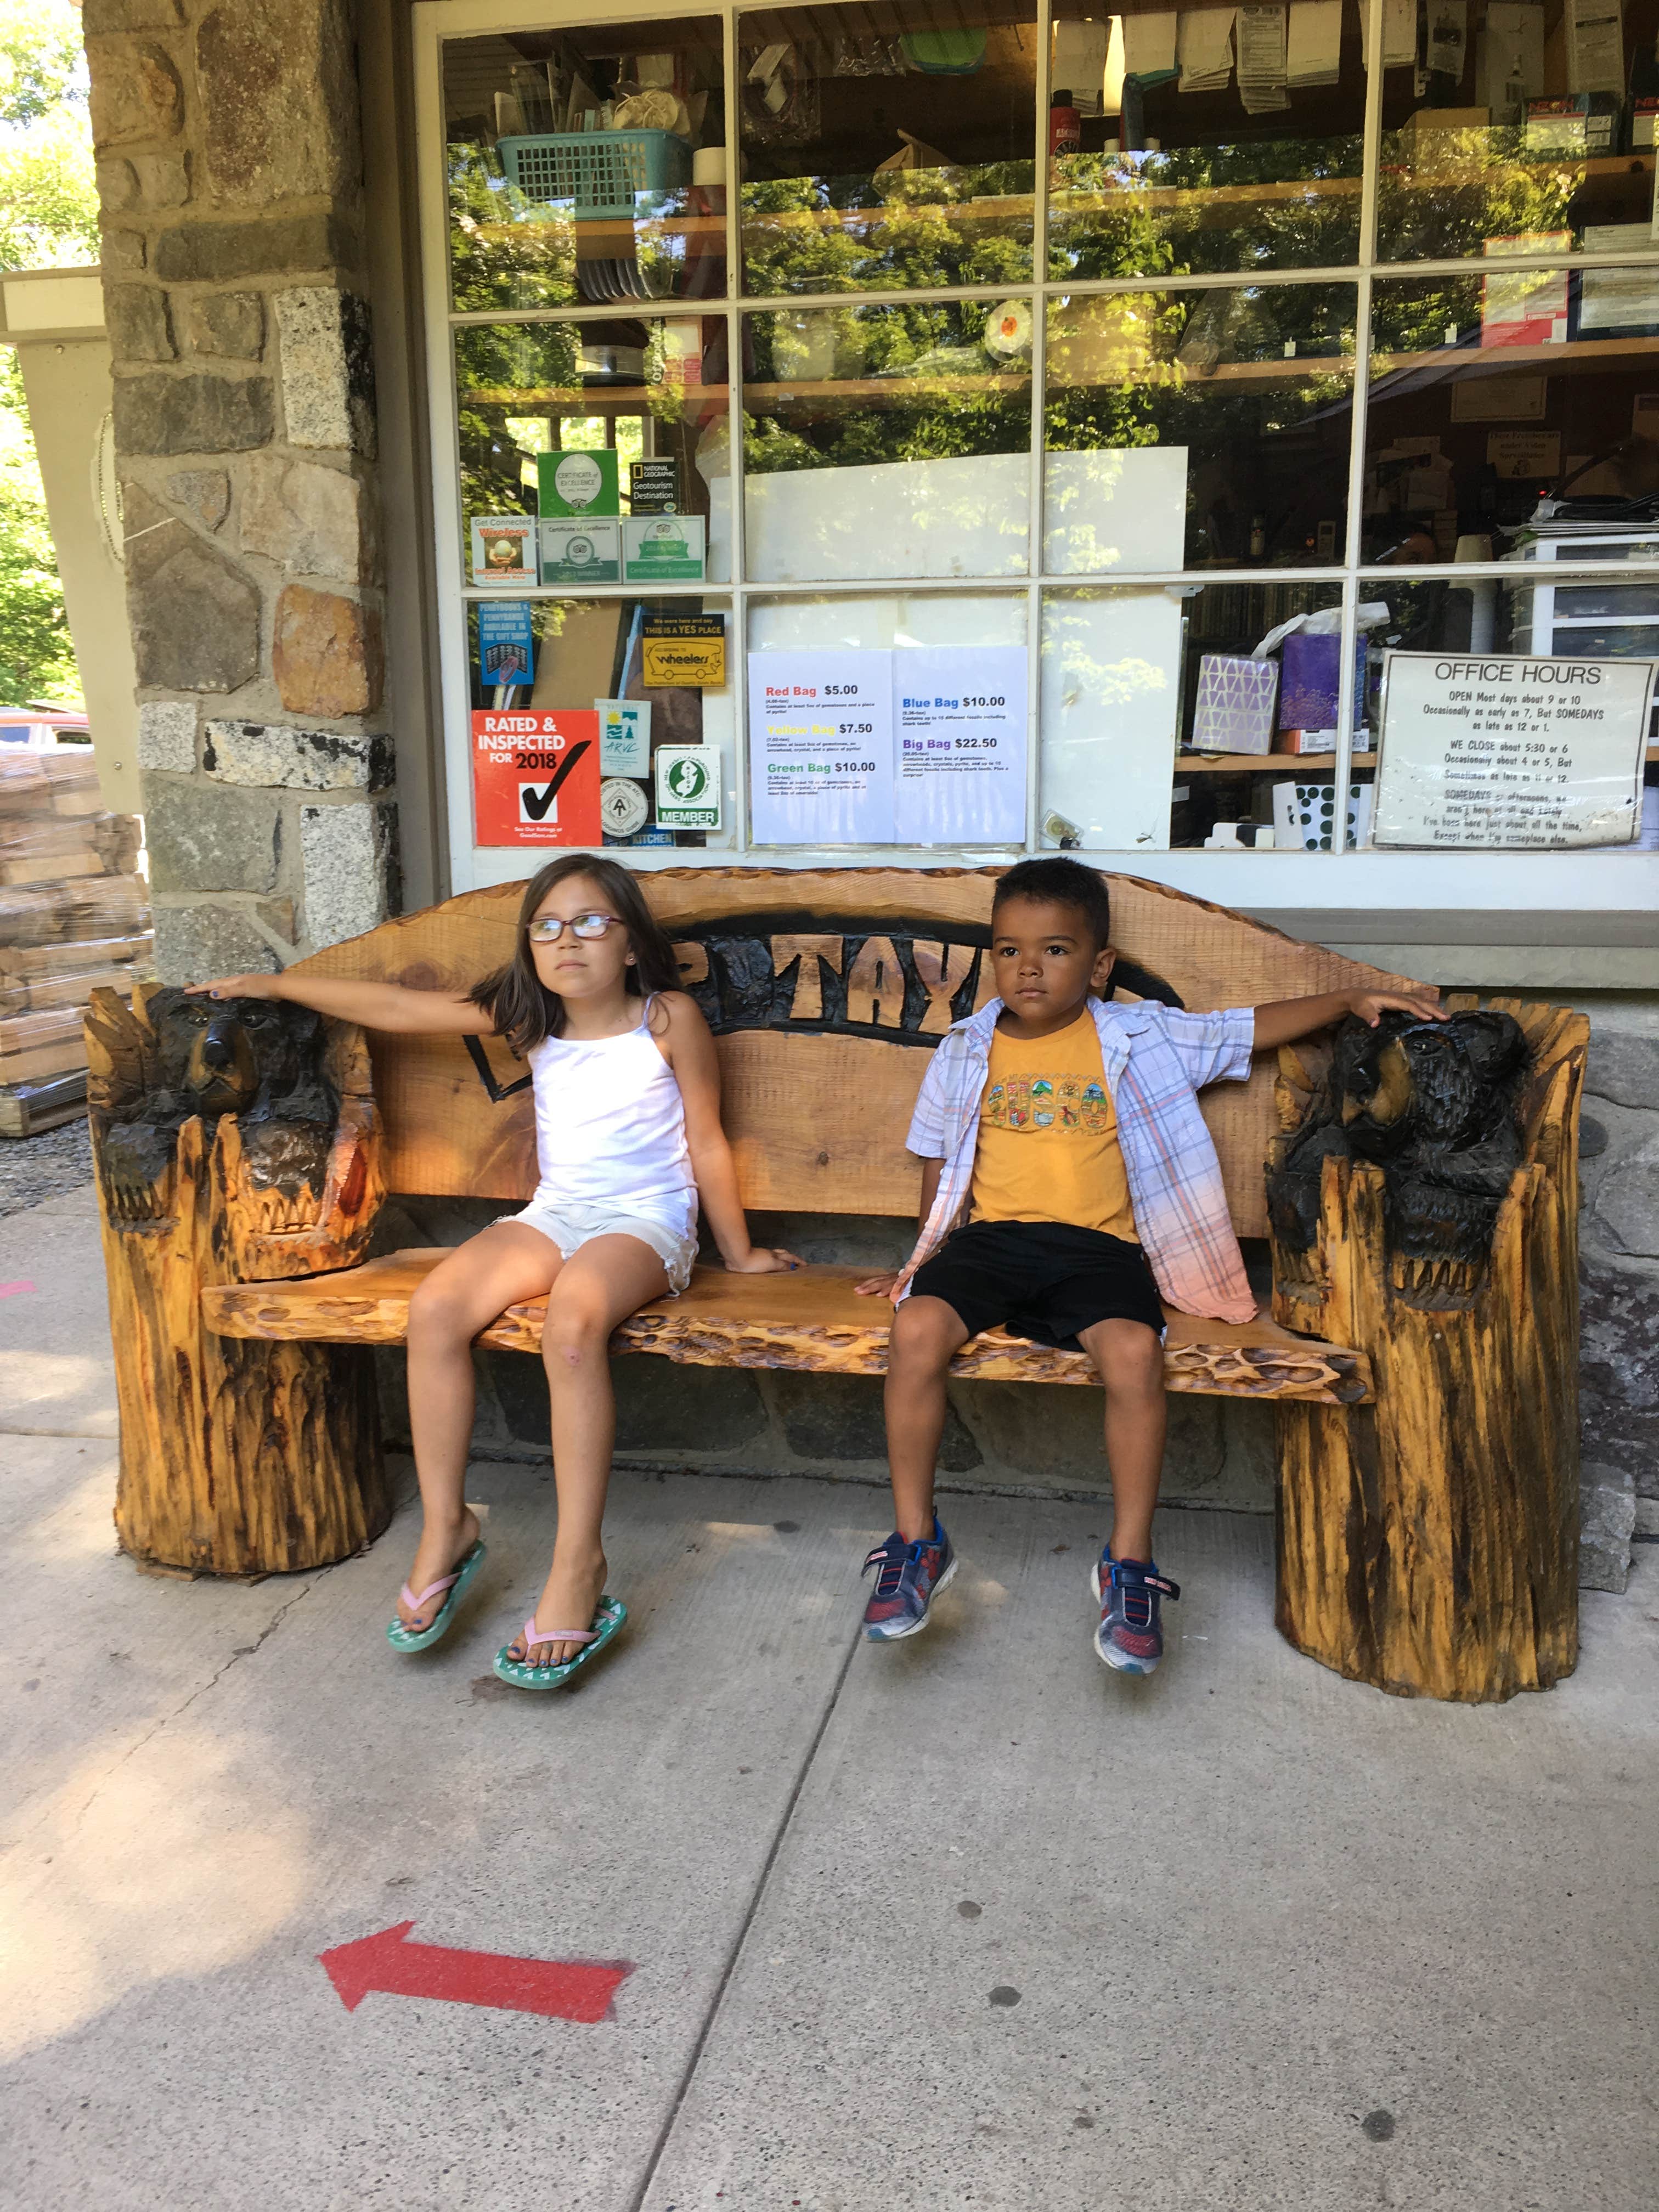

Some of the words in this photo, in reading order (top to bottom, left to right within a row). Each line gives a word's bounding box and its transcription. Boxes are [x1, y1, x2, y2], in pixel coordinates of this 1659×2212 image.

[478, 528, 529, 538] Wireless
[679, 625, 696, 634] YES
[656, 653, 709, 664] wheelers
[1435, 662, 1514, 682] OFFICE
[1521, 664, 1601, 685] HOURS
[766, 687, 789, 696] Red
[793, 686, 817, 697] Bag
[825, 685, 858, 695] $5.00
[902, 698, 930, 708] Blue
[935, 698, 958, 709] Bag
[963, 697, 1005, 707] $10.00
[1449, 691, 1472, 702] OPEN
[1476, 692, 1496, 702] Most
[1500, 693, 1517, 704] days
[1521, 694, 1543, 704] about
[1548, 695, 1555, 703] 9
[1571, 696, 1581, 705] 10
[1423, 704, 1470, 718] Occasionally
[1488, 708, 1506, 719] early
[1524, 708, 1533, 719] 7,
[1537, 708, 1551, 718] But
[1555, 708, 1605, 720] SOMEDAYS
[485, 717, 538, 732] RATED
[542, 717, 557, 732] &
[767, 725, 808, 735] Yellow
[811, 724, 836, 736] Bag
[839, 724, 872, 734] $7.50
[1485, 720, 1500, 730] late
[1517, 723, 1526, 731] 12
[478, 735, 566, 750] INSPECTED
[903, 740, 923, 751] Big
[927, 739, 951, 751] Bag
[955, 738, 997, 748] $22.50
[1451, 740, 1463, 750] WE
[1468, 740, 1496, 751] CLOSE
[1499, 742, 1521, 752] about
[1525, 743, 1545, 753] 5:30
[1562, 744, 1568, 754] 6
[490, 753, 513, 763] FOR
[516, 753, 557, 769] 2018
[1444, 753, 1492, 766] Occasionally
[1497, 755, 1517, 765] about
[1521, 757, 1528, 766] 4
[1544, 758, 1553, 769] 5,
[1558, 757, 1572, 768] But
[768, 763, 804, 773] Green
[808, 763, 831, 774] Bag
[834, 762, 876, 772] $10.00
[1444, 769, 1486, 780] Sometimes
[1503, 772, 1517, 781] late
[1444, 789, 1492, 800] SOMEDAYS
[662, 811, 714, 822] MEMBER
[1464, 818, 1481, 827] here
[1486, 820, 1502, 830] just
[1505, 820, 1527, 829] about
[1532, 820, 1541, 830] all
[1545, 821, 1558, 830] the
[1562, 822, 1582, 832] time,
[1434, 830, 1461, 842] Except
[988, 1079, 1109, 1129] CUSCO
